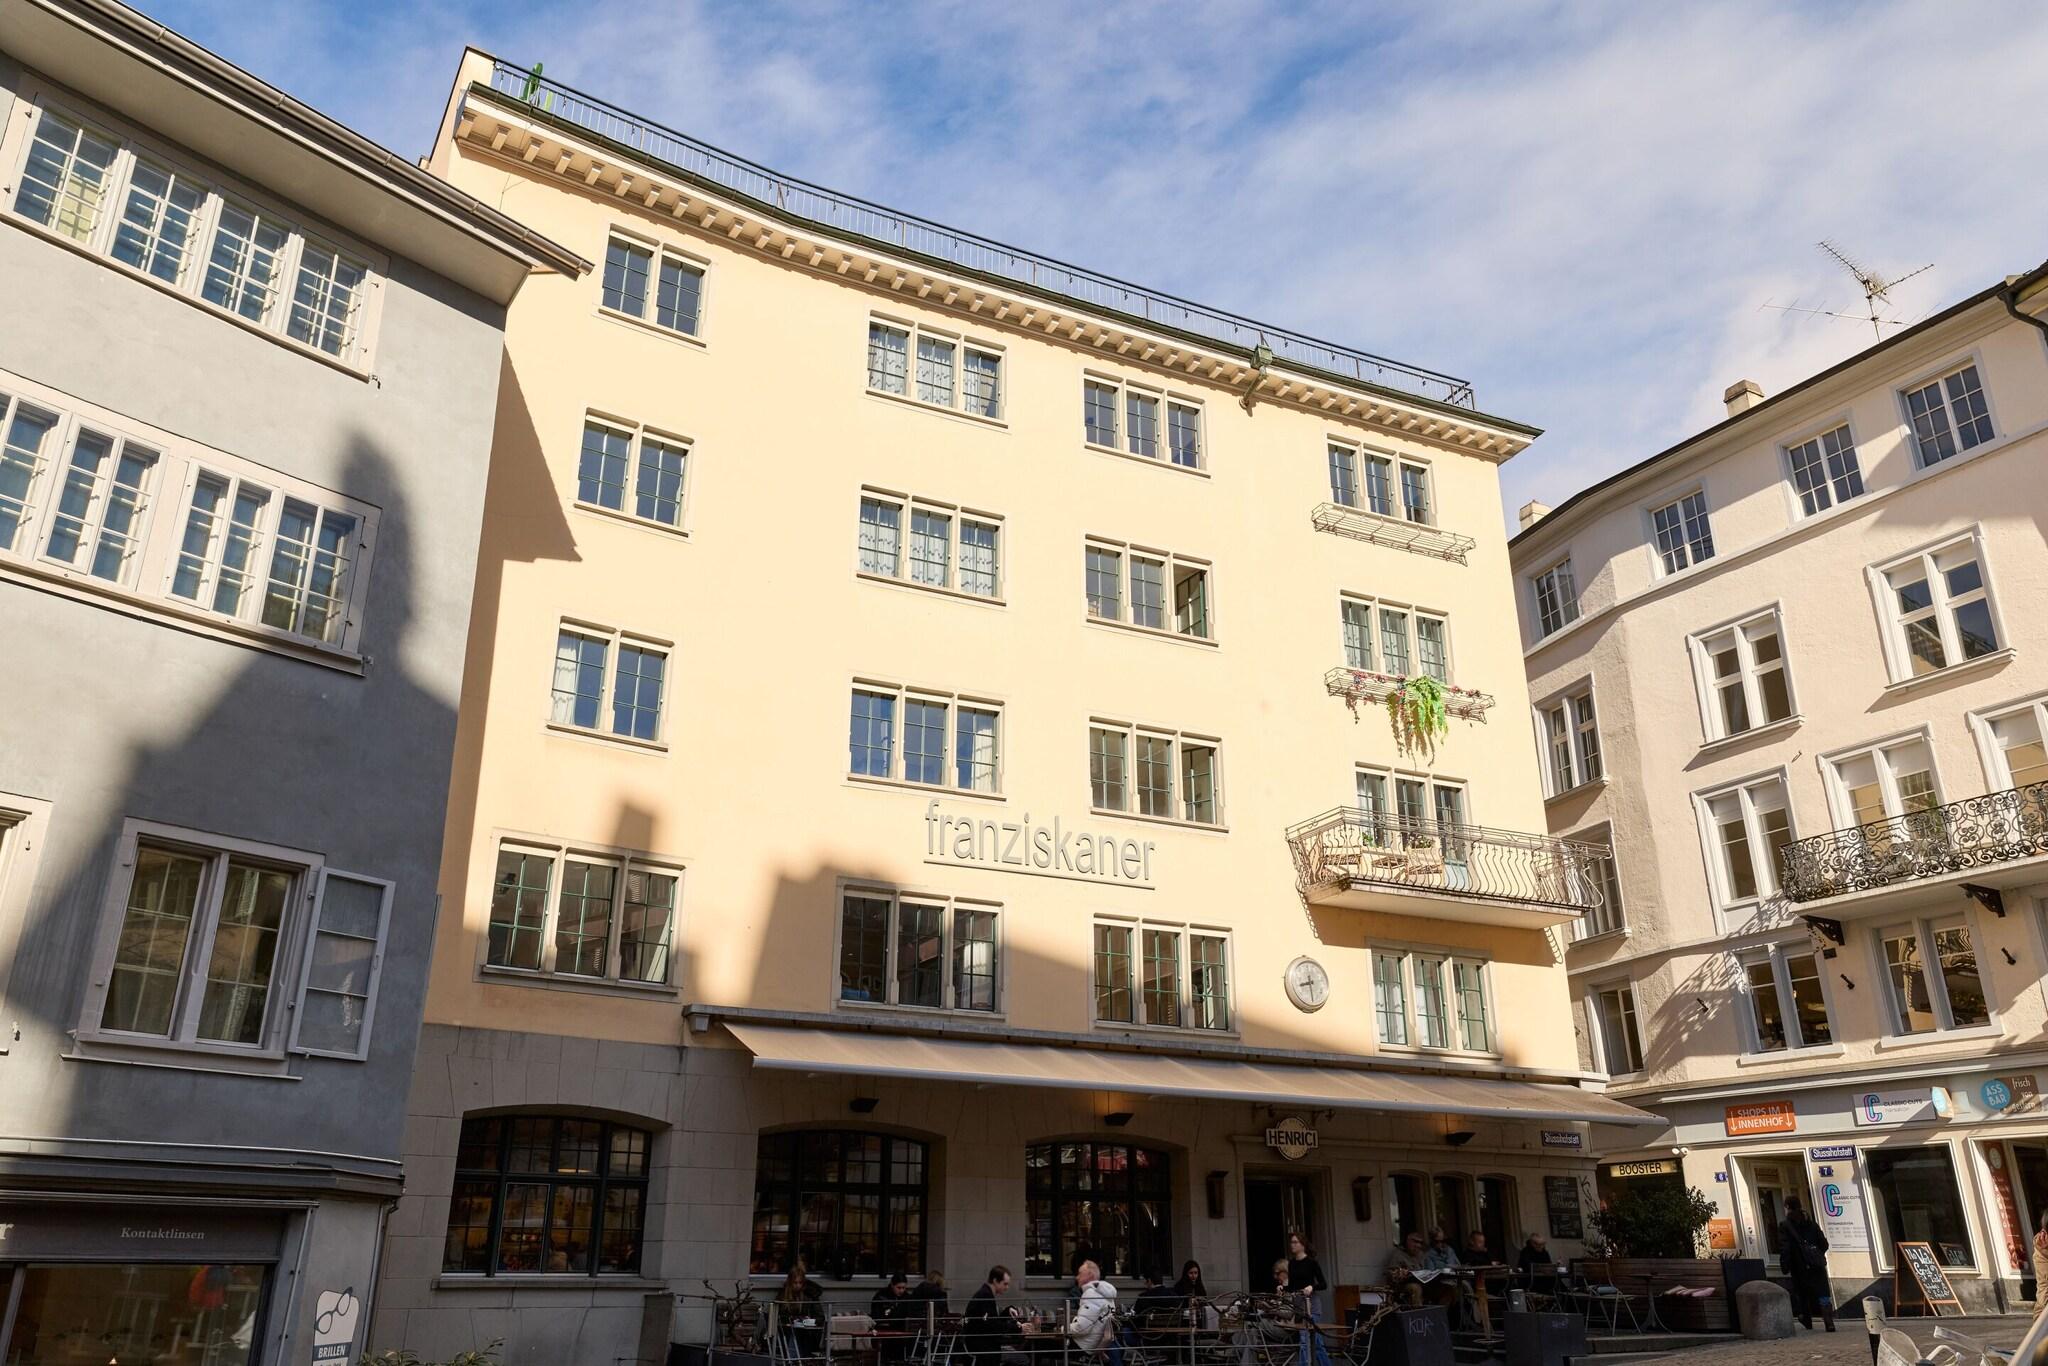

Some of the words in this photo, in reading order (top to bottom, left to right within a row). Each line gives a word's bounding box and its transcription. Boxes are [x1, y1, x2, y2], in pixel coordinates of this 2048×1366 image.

[925, 800, 1156, 881] franziskaner
[1985, 1084, 2003, 1097] ASS
[1988, 1094, 2007, 1106] BAR
[1737, 1106, 1767, 1119] SHOPS
[1768, 1105, 1781, 1116] IM
[1738, 1116, 1784, 1129] INNENHOF
[1268, 1130, 1317, 1147] HENRICI
[1619, 1162, 1662, 1175] BOOSTER
[120, 1227, 205, 1240] Kontaktlinsen
[318, 1345, 346, 1358] BRILLEN
